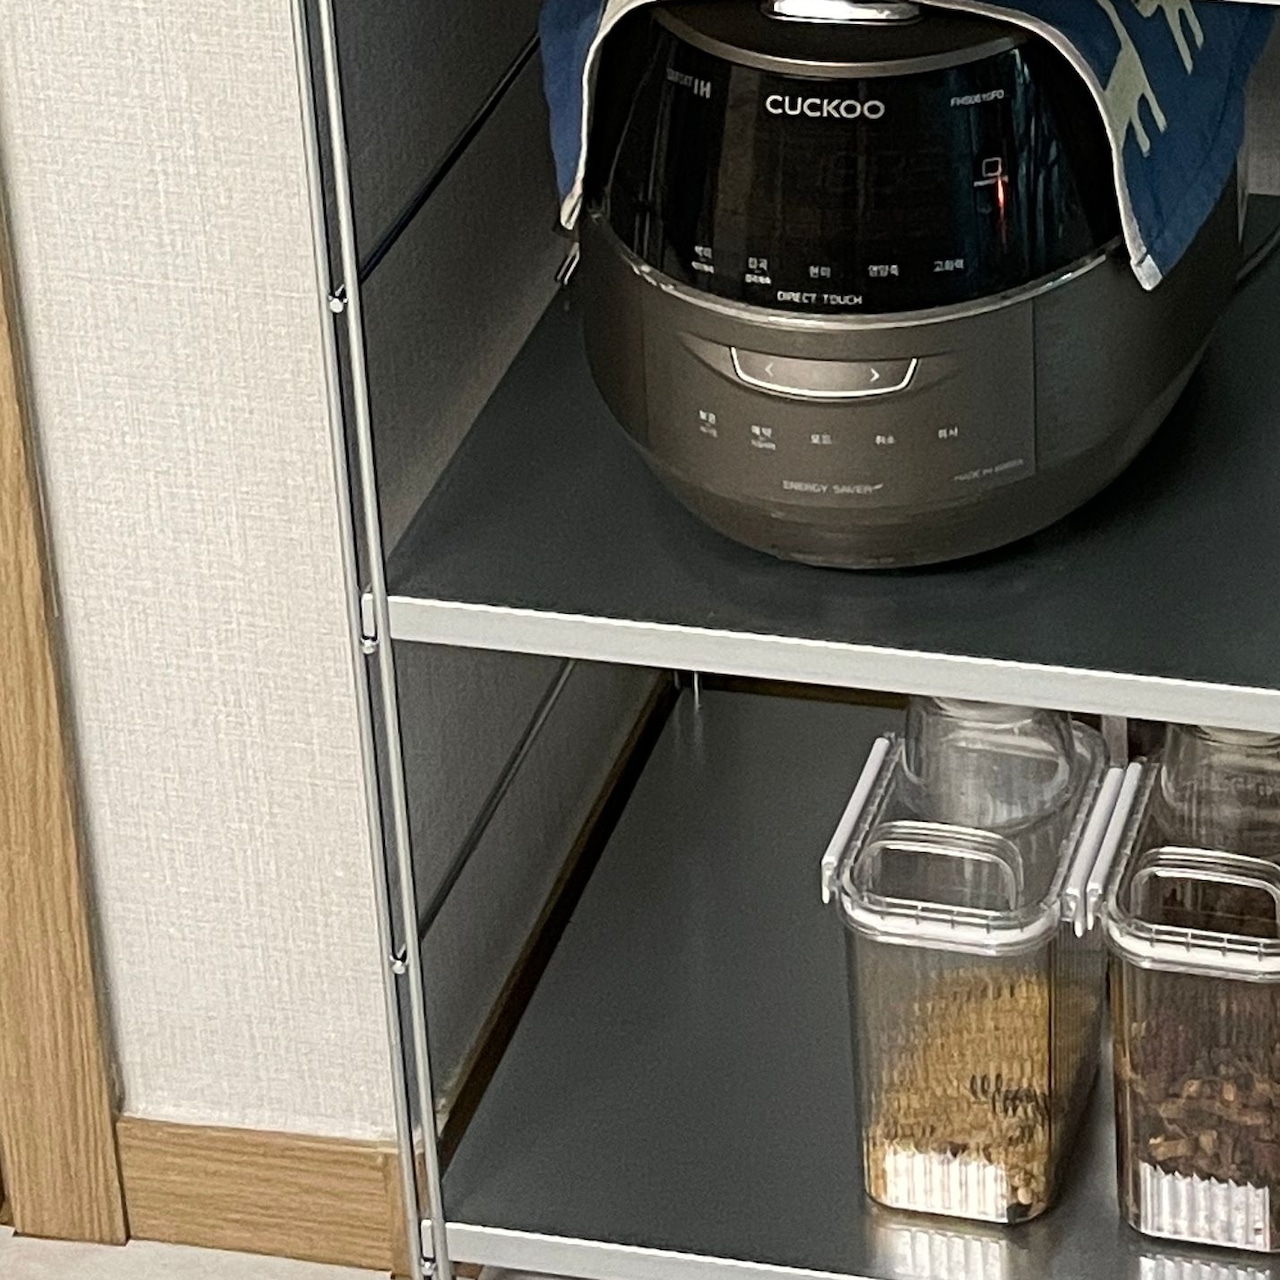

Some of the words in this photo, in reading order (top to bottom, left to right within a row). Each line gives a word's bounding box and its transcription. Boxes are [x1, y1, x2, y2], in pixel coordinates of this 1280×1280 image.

[765, 95, 885, 119] CUCKOO
[777, 290, 817, 304] DIRECT
[823, 294, 862, 305] TOUCH
[783, 480, 828, 493] ENERGY
[832, 484, 873, 494] SAVER
